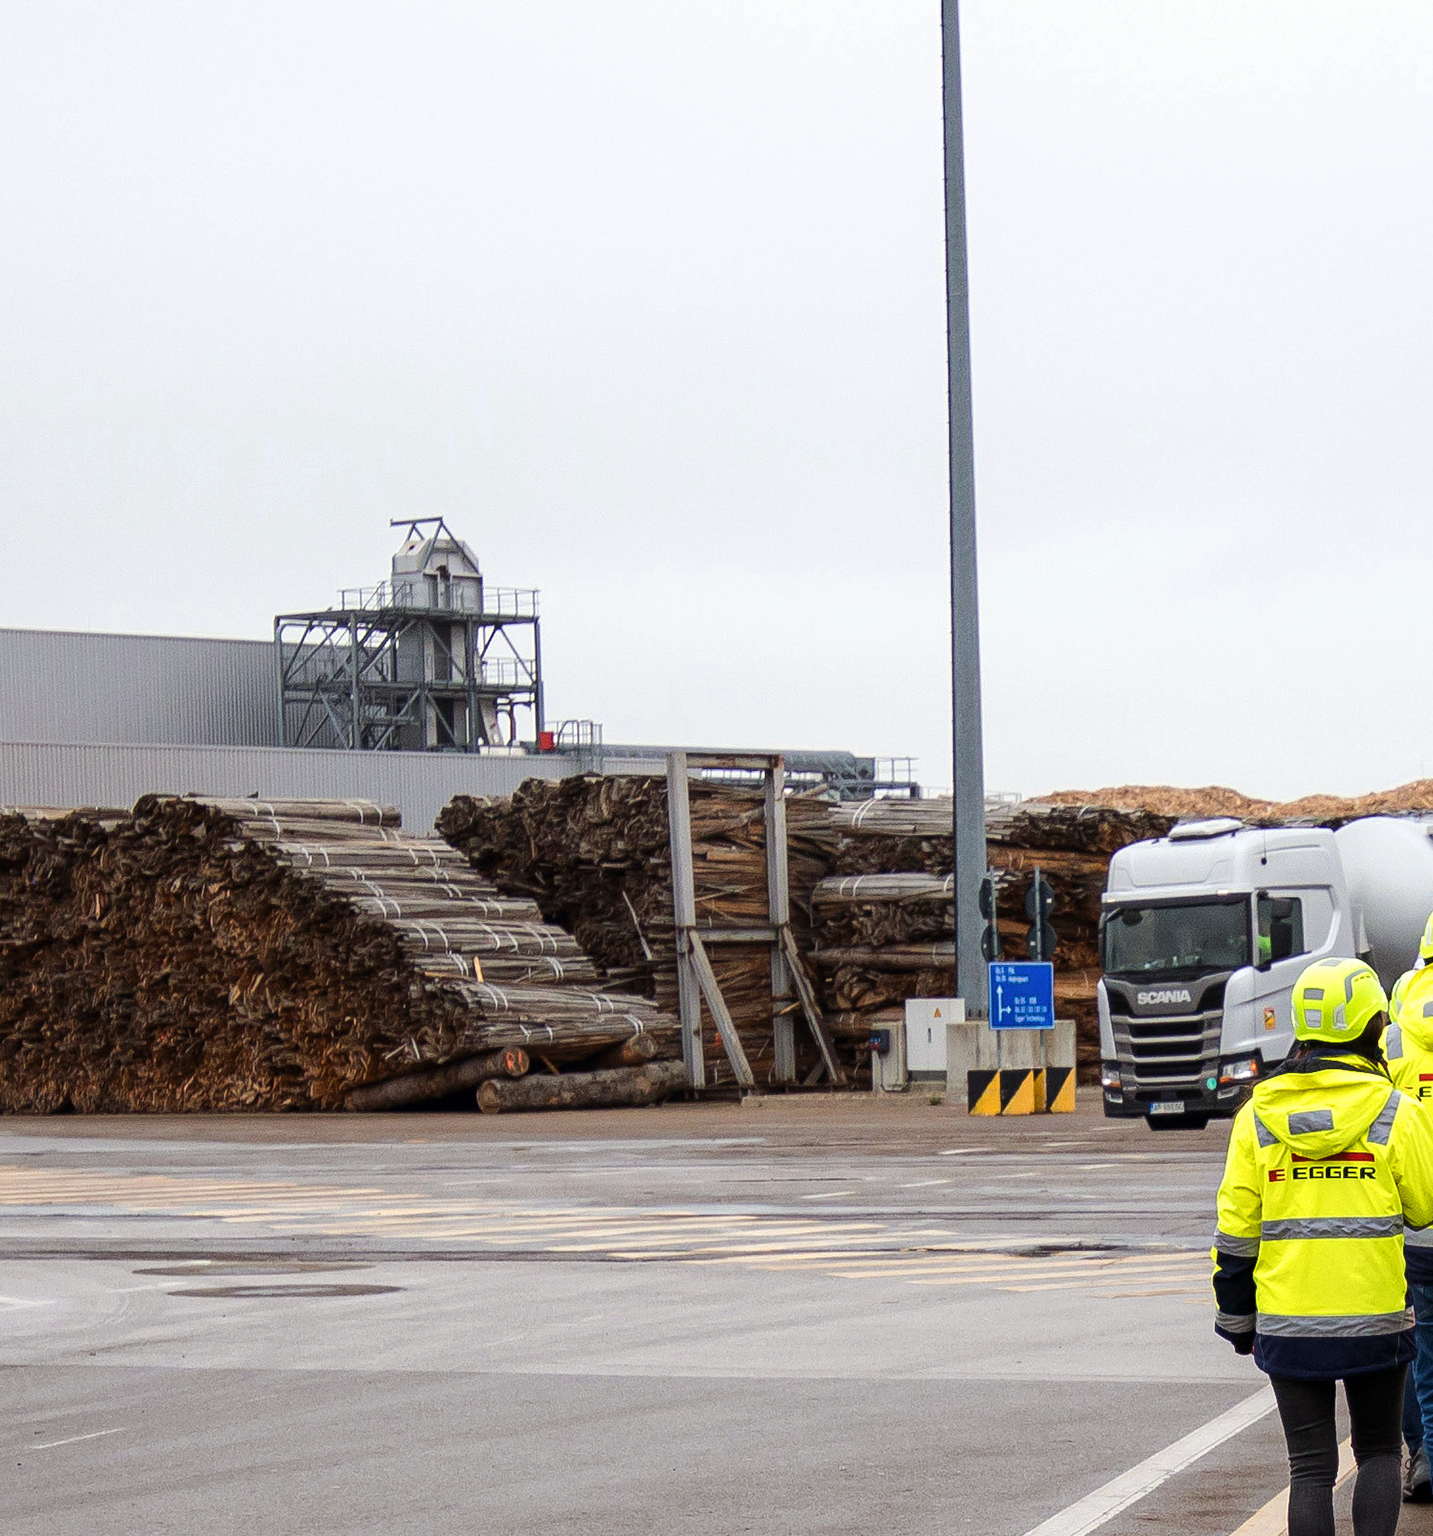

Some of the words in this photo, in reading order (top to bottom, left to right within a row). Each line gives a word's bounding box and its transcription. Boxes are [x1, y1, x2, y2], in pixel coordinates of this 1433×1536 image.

[1137, 989, 1192, 1005] SCANIA
[1268, 1168, 1286, 1182] E
[1293, 1166, 1376, 1180] EGGER
